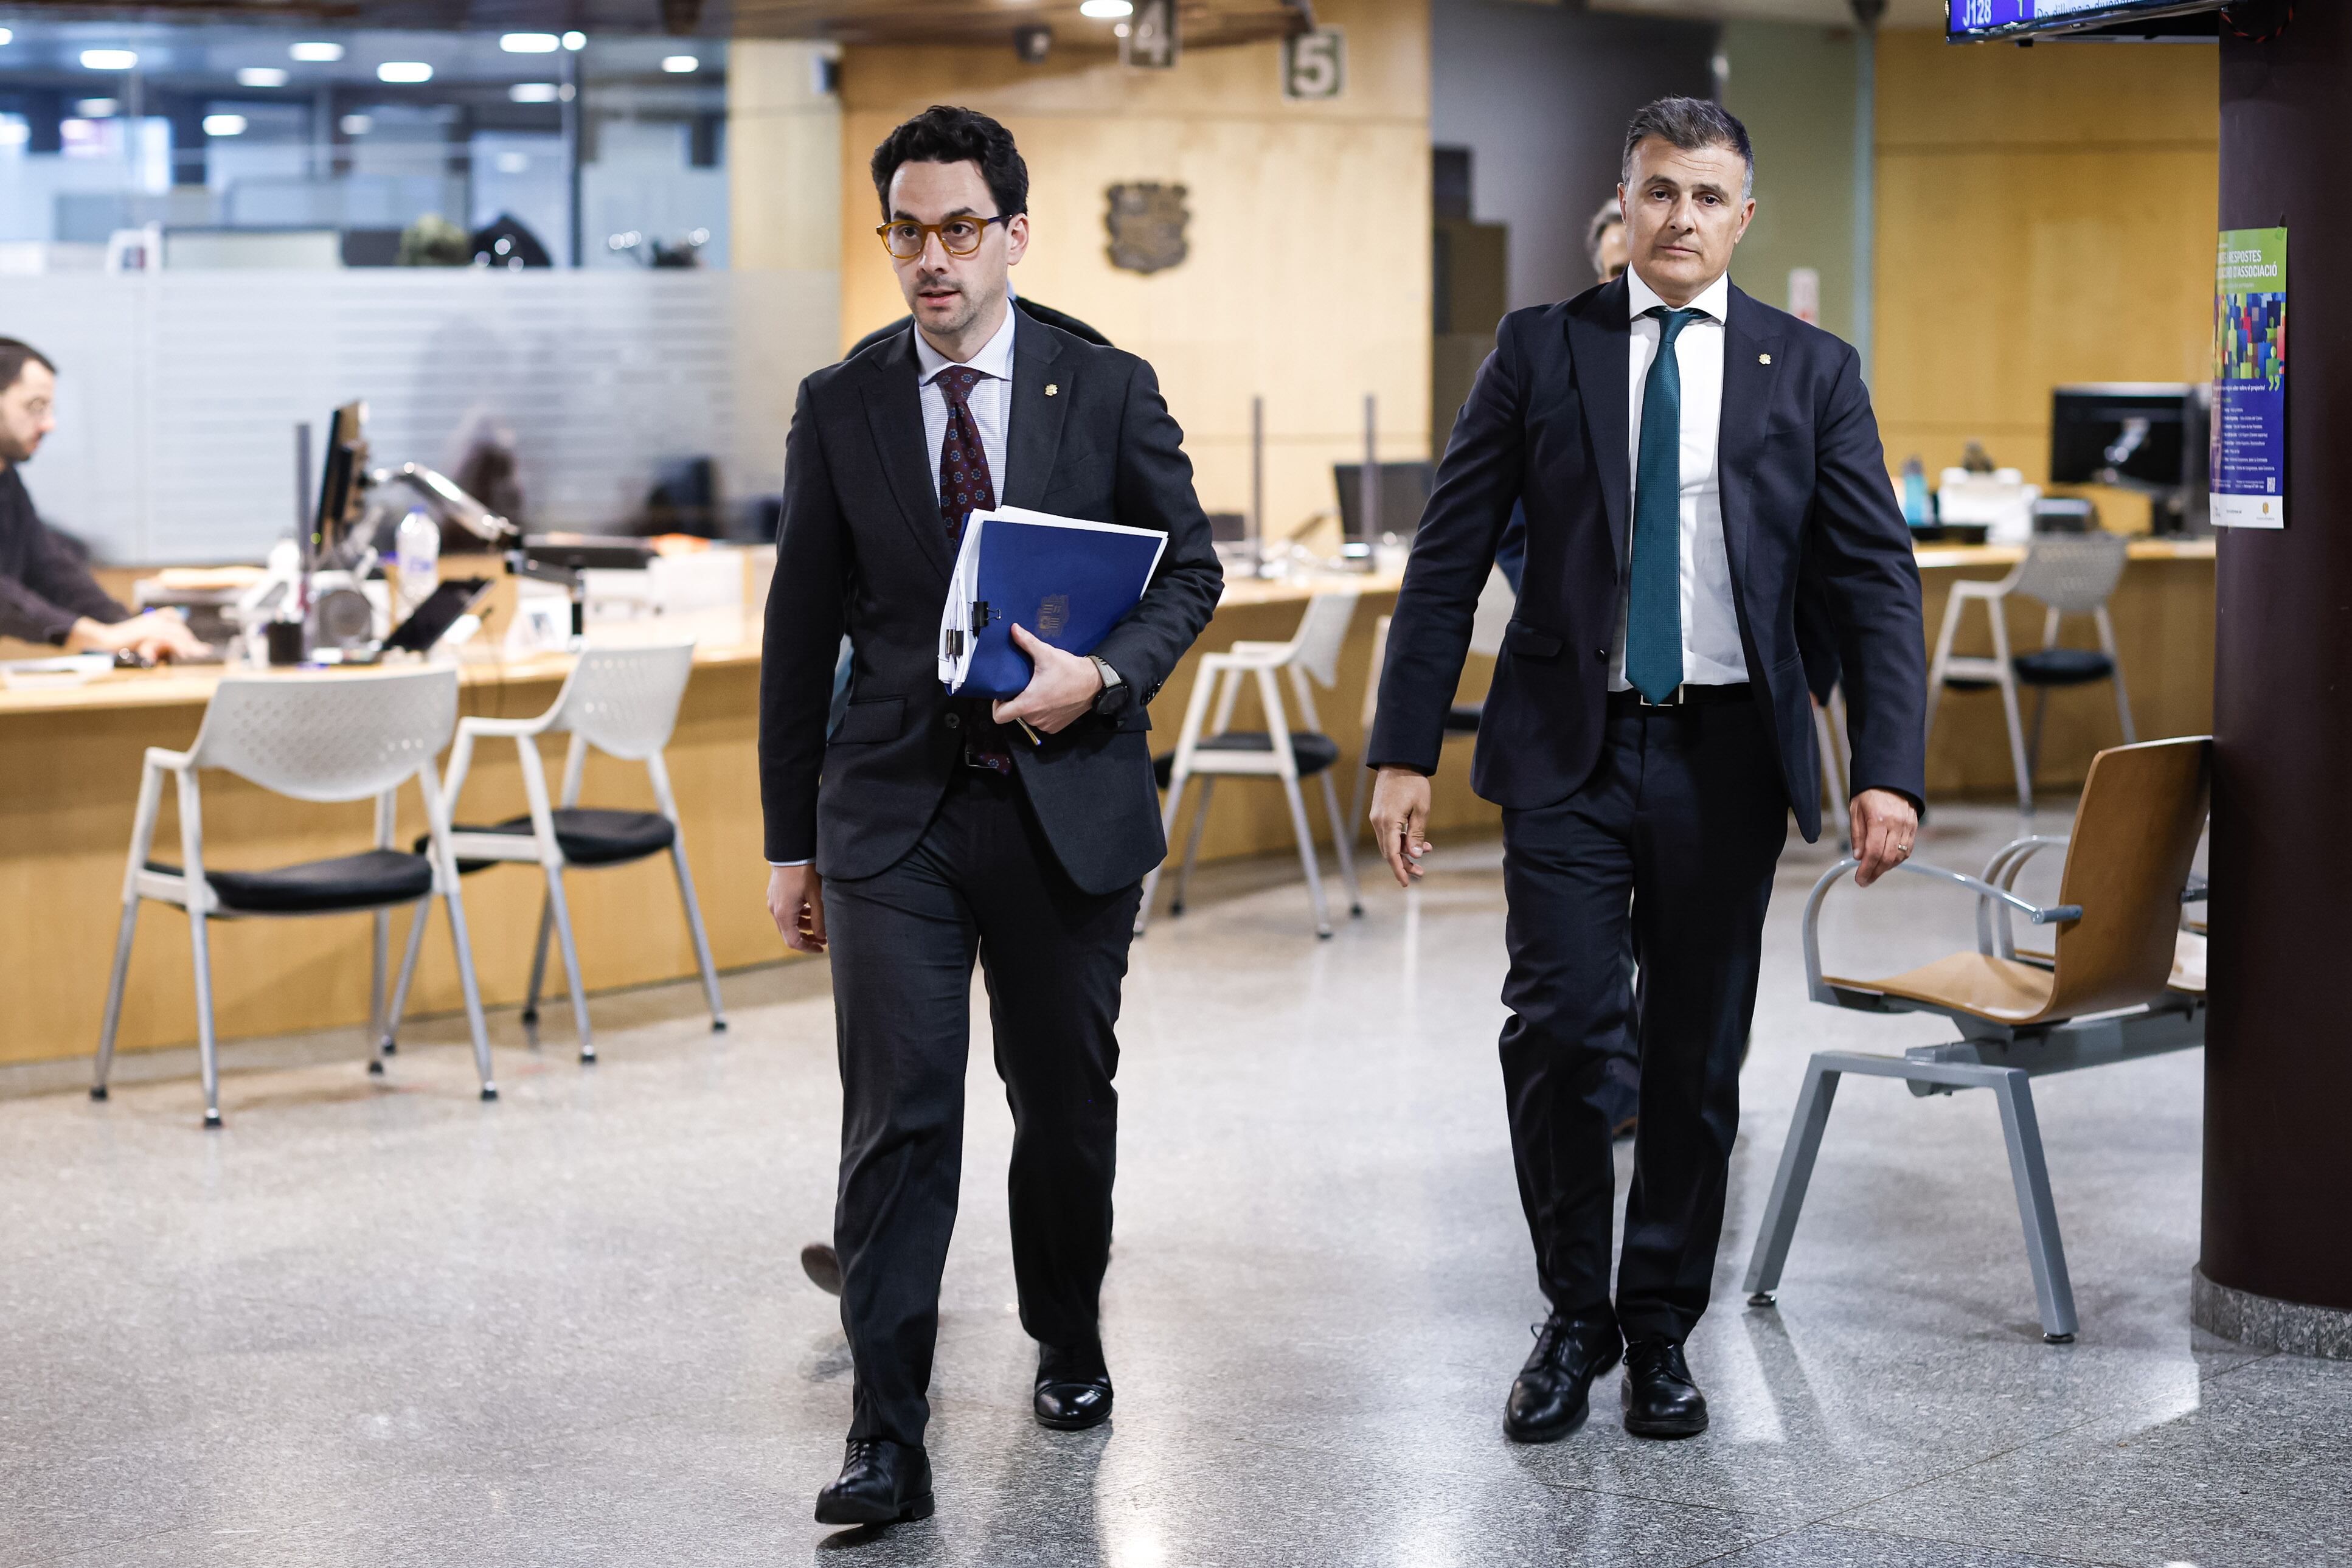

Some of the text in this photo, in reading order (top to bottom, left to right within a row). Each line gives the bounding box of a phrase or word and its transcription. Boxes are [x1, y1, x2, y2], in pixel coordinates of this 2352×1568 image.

[1962, 0, 1992, 27] J128
[1134, 0, 1168, 64] 4
[1293, 35, 1336, 94] 5
[2229, 249, 2261, 263] RESPOSTES
[2233, 260, 2278, 277] D'ASSOCIACIÓ
